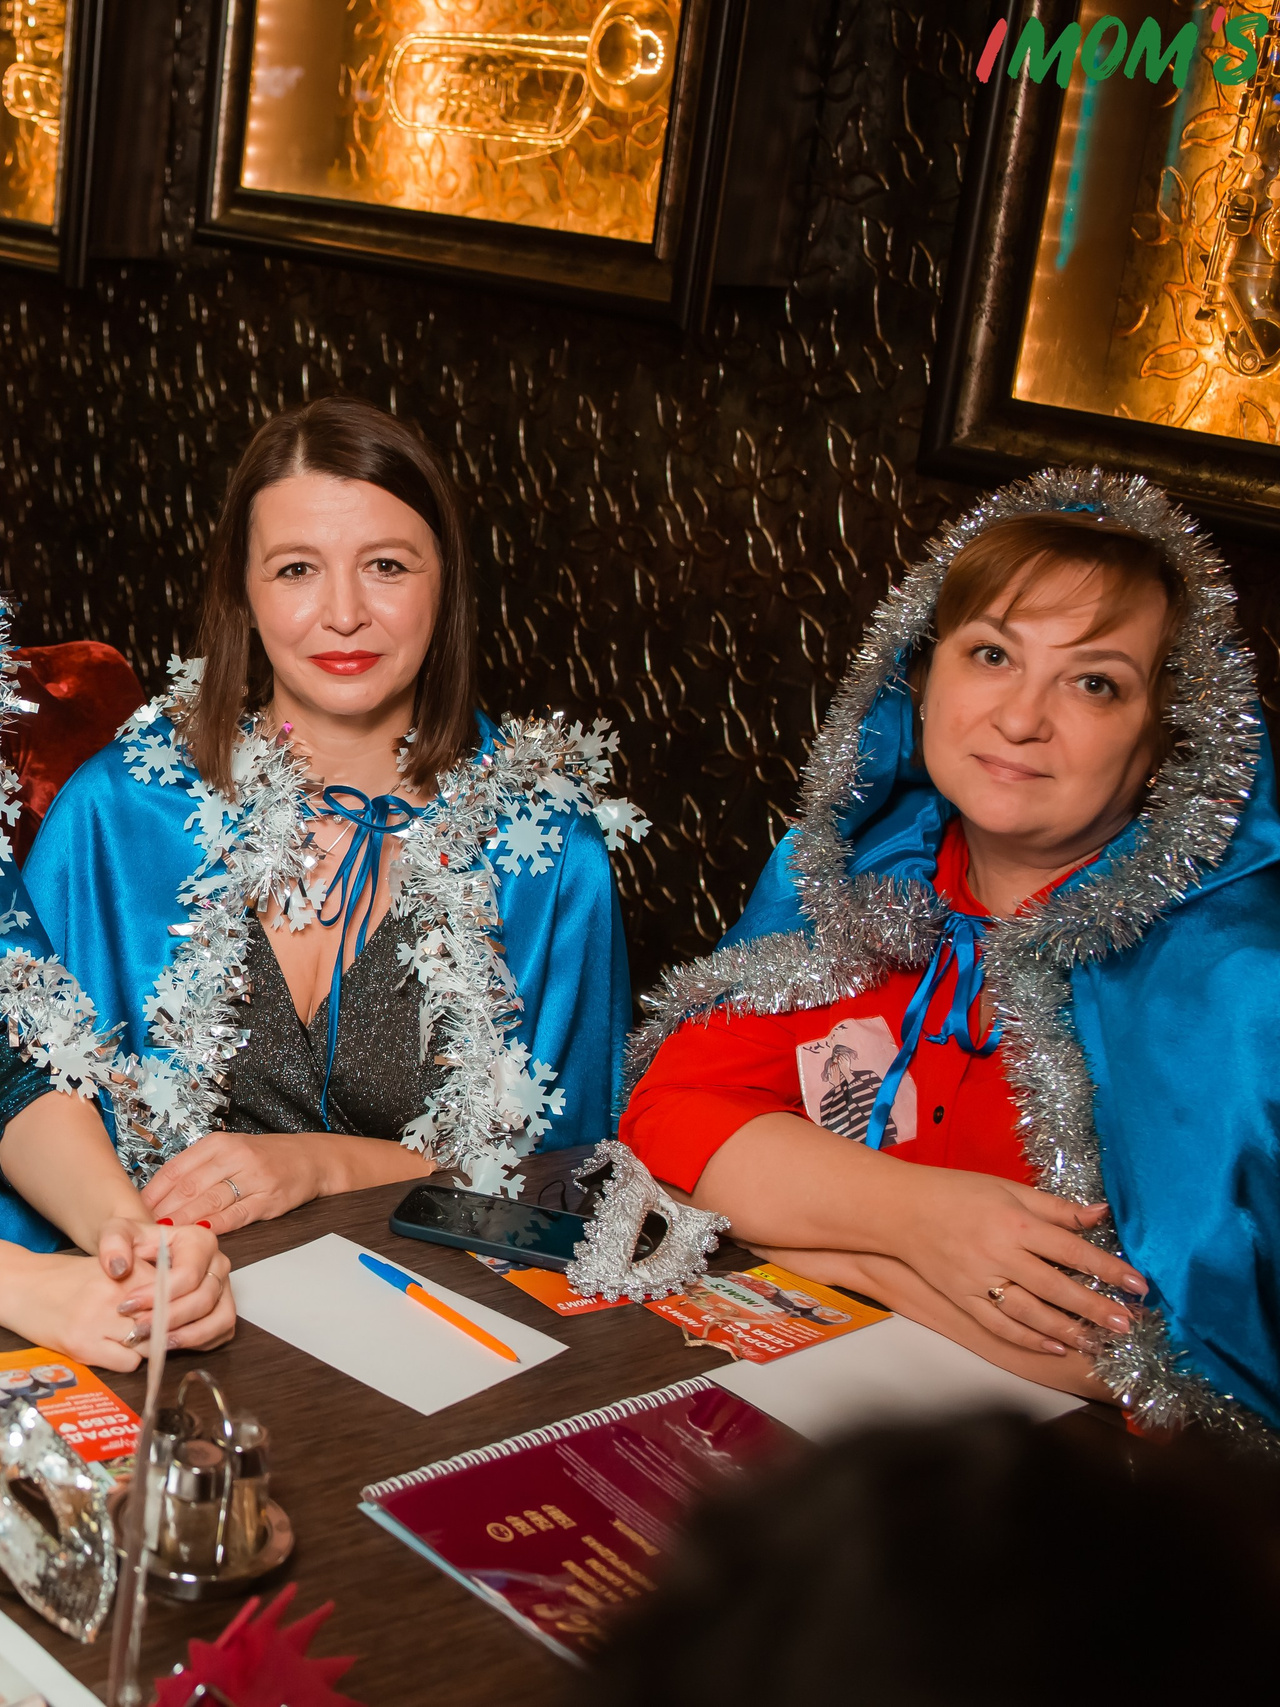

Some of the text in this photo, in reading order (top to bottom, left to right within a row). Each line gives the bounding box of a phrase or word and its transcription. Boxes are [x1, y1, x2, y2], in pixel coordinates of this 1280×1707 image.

[750, 1328, 796, 1349] СЕБЯ
[77, 1413, 129, 1429] СЕБЯ
[63, 1423, 141, 1444] ПОРАД
